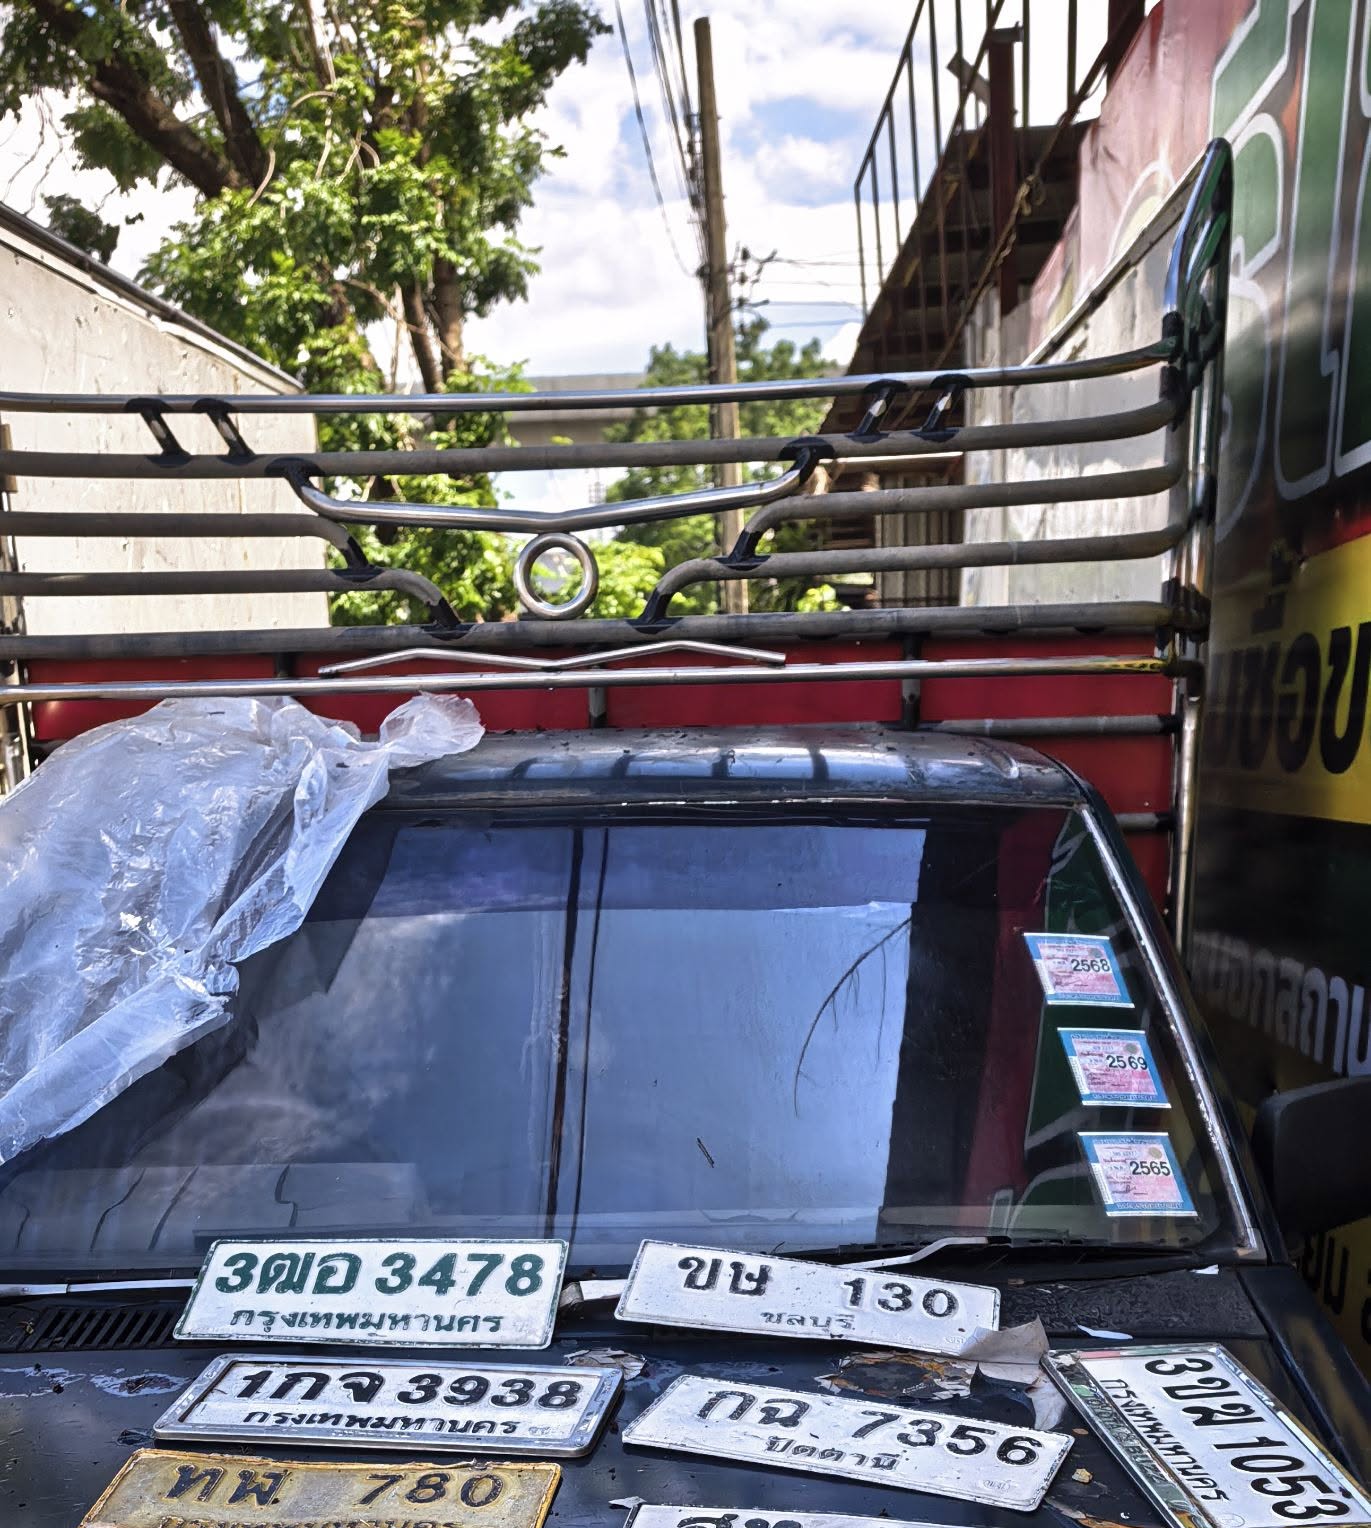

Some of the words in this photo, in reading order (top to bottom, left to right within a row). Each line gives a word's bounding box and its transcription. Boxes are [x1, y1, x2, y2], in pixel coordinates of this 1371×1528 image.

[1070, 957, 1111, 974] 2568
[1105, 1054, 1148, 1071] 2569
[1129, 1160, 1171, 1178] 2565
[214, 1252, 362, 1295] 3ฒอ
[375, 1252, 545, 1297] 3478
[677, 1255, 772, 1297] ขษ
[842, 1277, 959, 1319] 130
[230, 1308, 505, 1334] กรุงเทพมหานคร
[760, 1311, 856, 1332] ชลบุรี
[235, 1369, 385, 1403] 1กจ
[396, 1374, 584, 1410] 3938
[242, 1409, 522, 1435] กรงเทพมหานคร
[696, 1390, 812, 1428] กฉ
[851, 1410, 1043, 1466] 7356
[1099, 1378, 1231, 1503] กรงเทพมหานคร
[1145, 1357, 1267, 1427] 3ขฆ
[1213, 1435, 1351, 1521] 1053
[764, 1435, 901, 1471] ปัตตานี
[355, 1471, 505, 1509] 780
